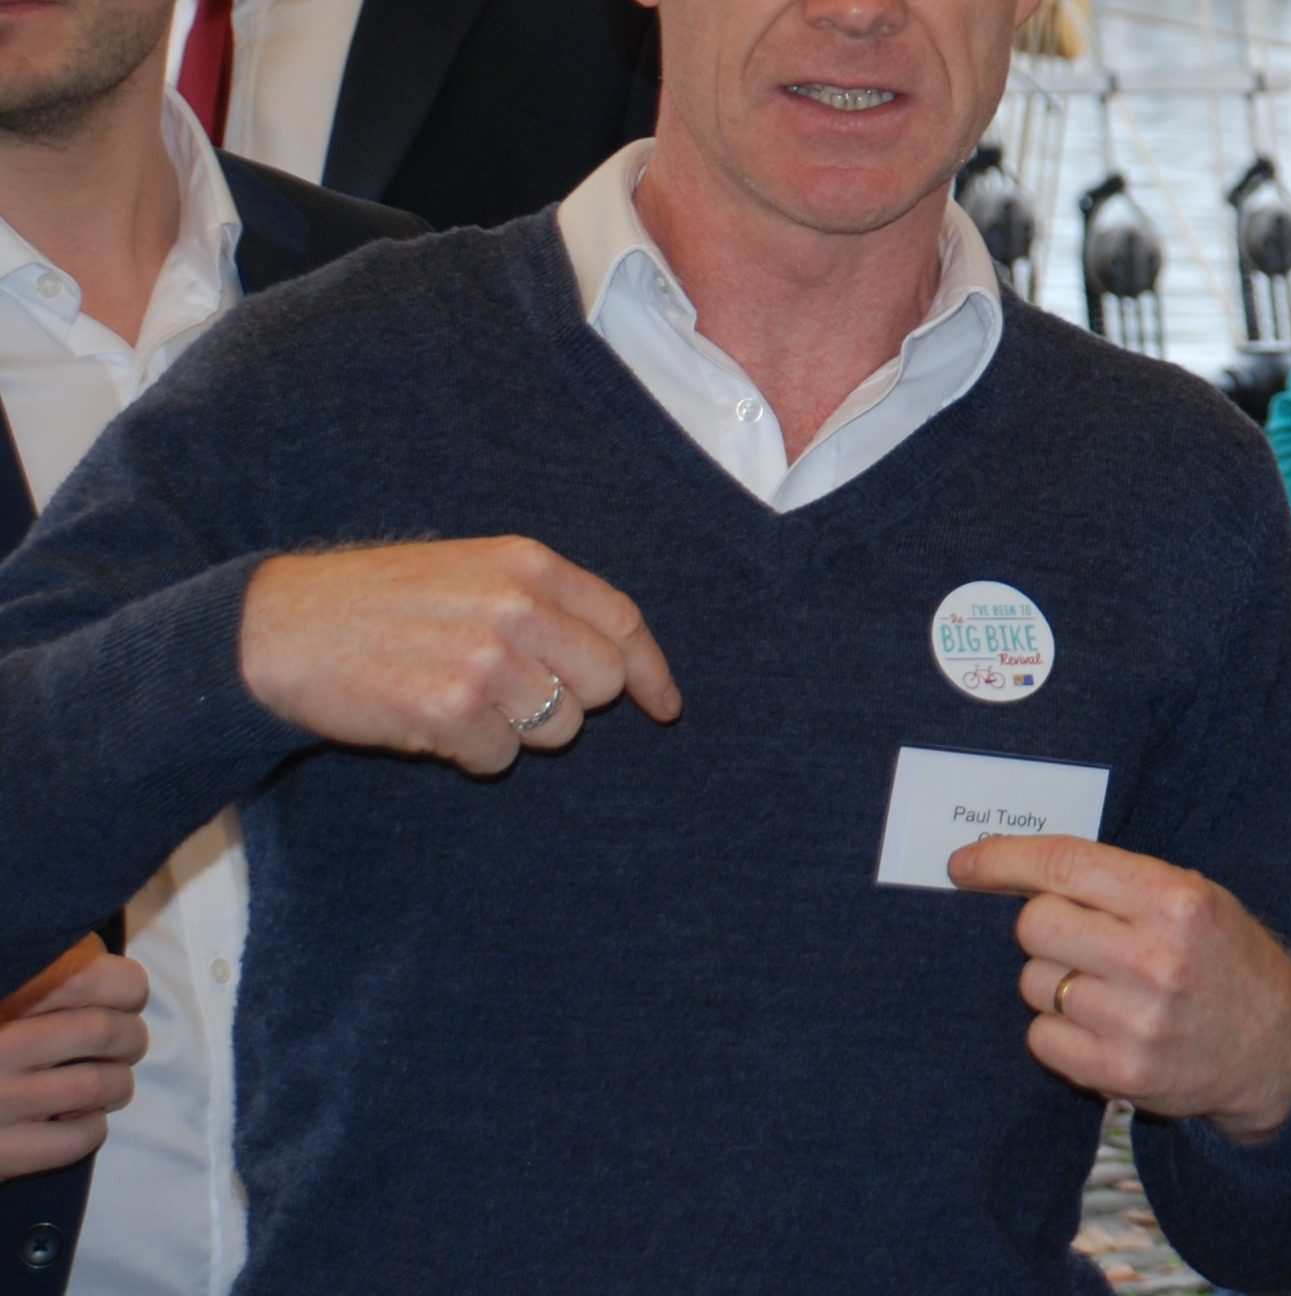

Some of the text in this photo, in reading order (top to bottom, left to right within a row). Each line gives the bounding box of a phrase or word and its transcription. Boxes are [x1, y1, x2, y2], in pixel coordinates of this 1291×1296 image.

[993, 604, 1017, 616] BEEN
[1021, 604, 1032, 616] TO
[940, 624, 1039, 653] BIG BIKE
[953, 805, 1047, 832] Paul Tuohy
